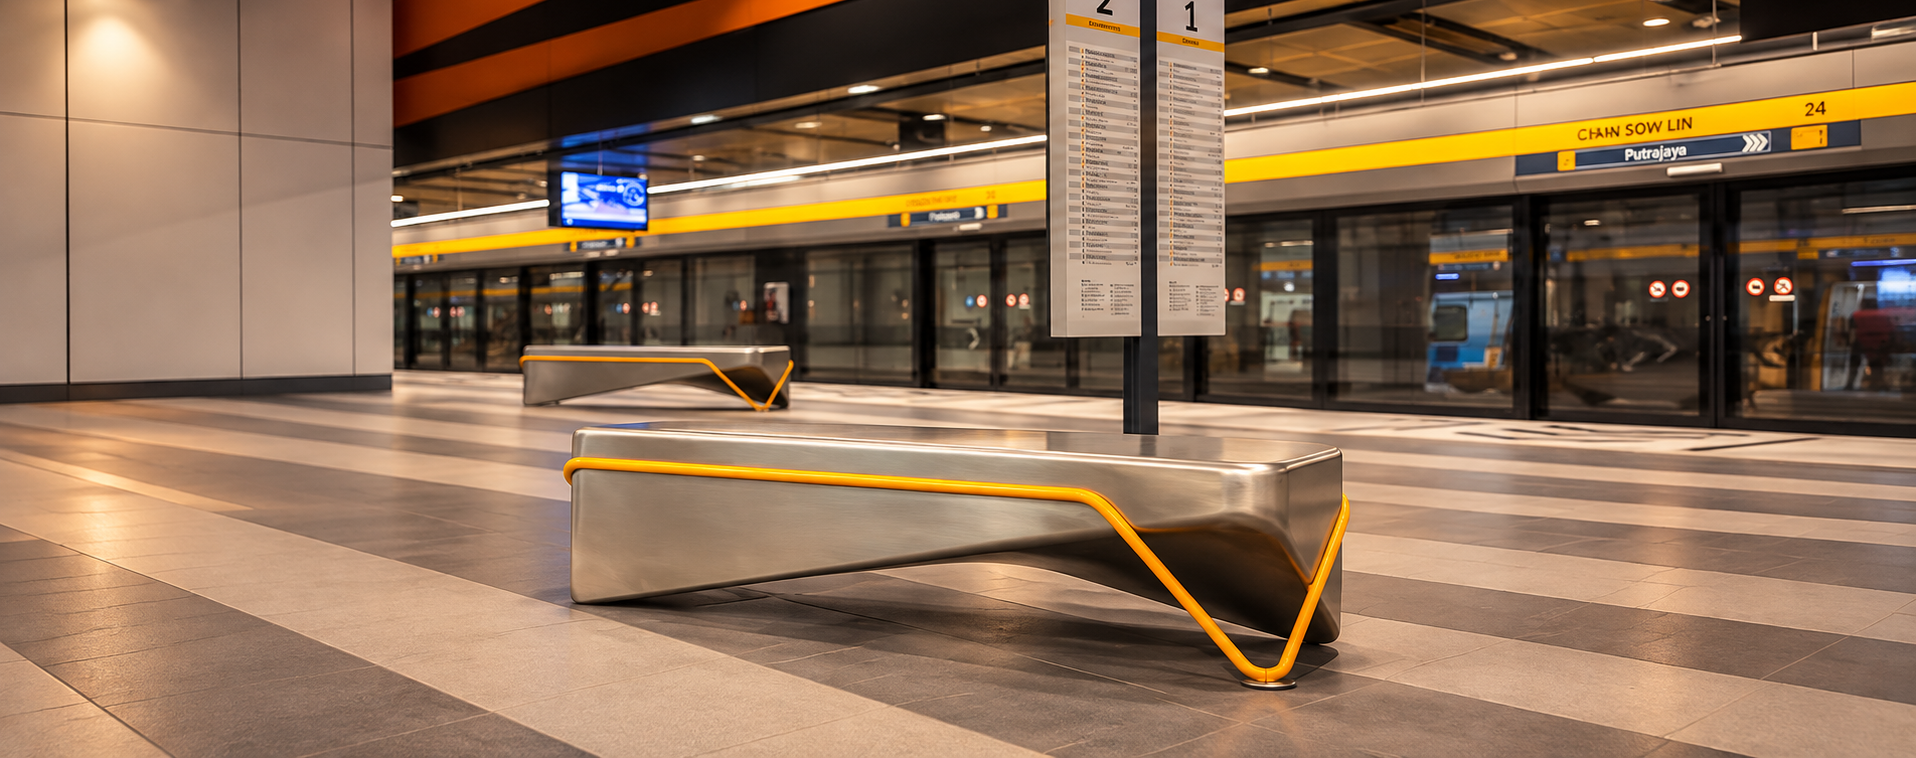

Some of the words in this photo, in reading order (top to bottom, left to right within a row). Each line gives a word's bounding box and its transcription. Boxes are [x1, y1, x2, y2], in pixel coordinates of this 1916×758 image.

[1184, 1, 1198, 32] 1
[1804, 101, 1827, 117] 24
[1625, 120, 1663, 136] SOW
[1667, 117, 1693, 132] LIN
[1624, 145, 1687, 162] Putrajaya
